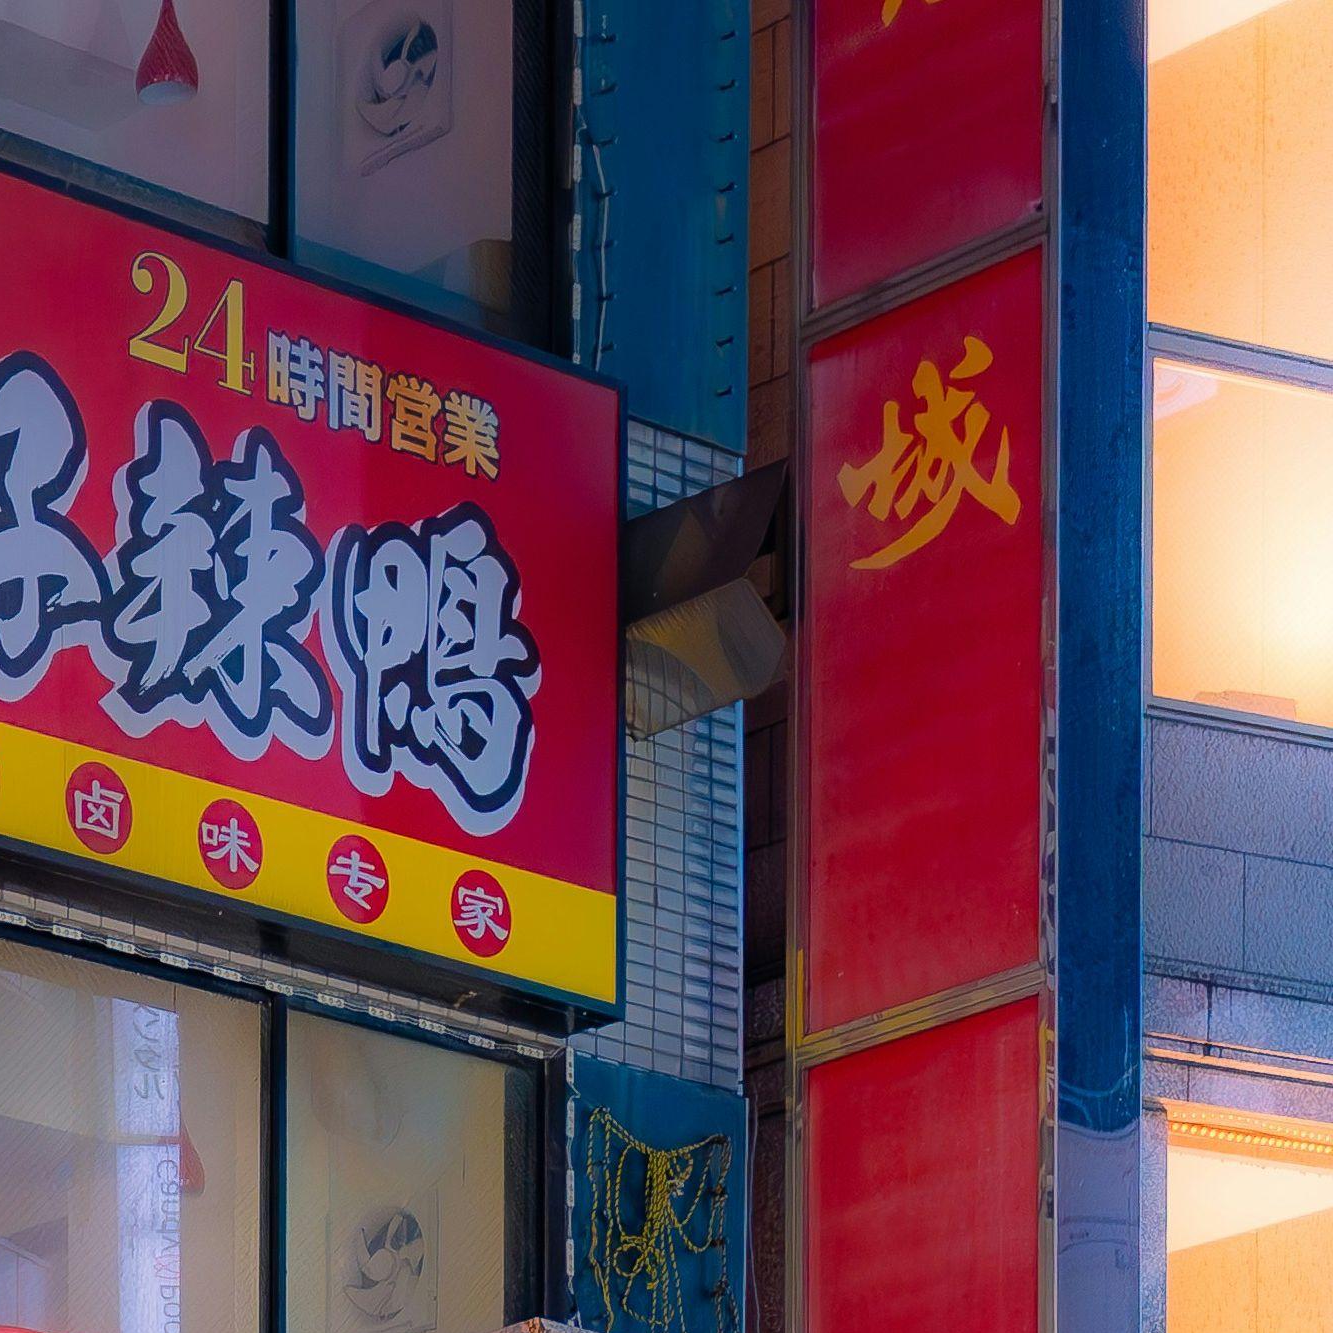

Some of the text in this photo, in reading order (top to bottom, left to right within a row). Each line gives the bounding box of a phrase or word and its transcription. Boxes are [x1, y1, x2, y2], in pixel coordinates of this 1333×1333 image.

[128, 251, 502, 481] 24時間営業
[836, 335, 1021, 571] 城
